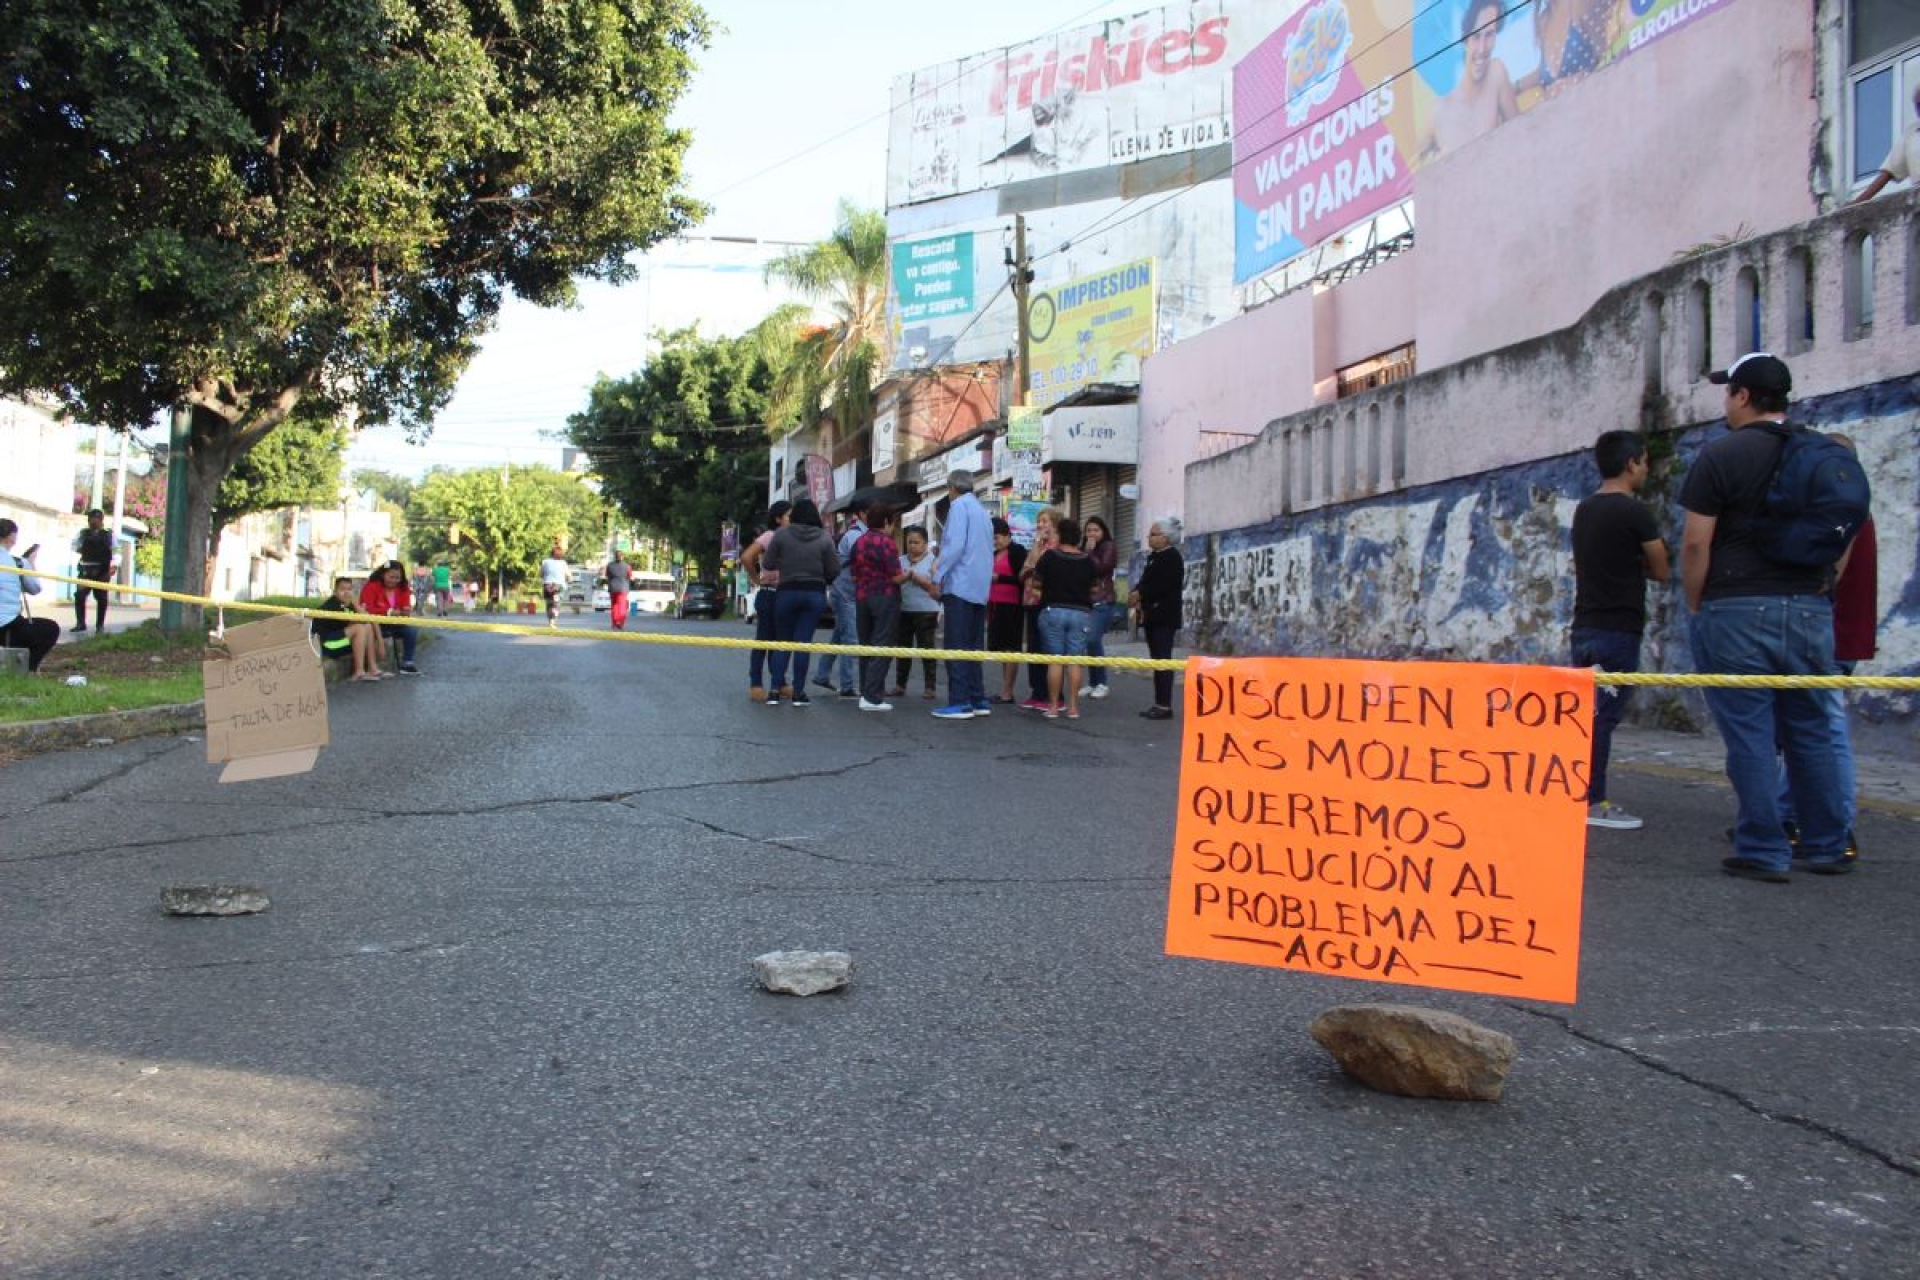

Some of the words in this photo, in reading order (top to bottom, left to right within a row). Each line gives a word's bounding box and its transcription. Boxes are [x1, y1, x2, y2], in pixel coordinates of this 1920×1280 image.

[988, 15, 1230, 118] Friskies
[1111, 133, 1151, 158] LLENA
[1158, 124, 1174, 150] DE
[1181, 122, 1214, 145] VIDA
[1255, 75, 1395, 196] VACACIONES
[1255, 193, 1293, 252] SIN
[1297, 132, 1396, 231] PARAR
[1057, 262, 1150, 312] IMPRESION
[274, 703, 295, 722] DE
[1195, 672, 1454, 730] DISCULPEN
[1486, 687, 1589, 738] POR
[1197, 732, 1287, 771] LAS
[1306, 738, 1590, 803] MOLESTIAS
[1192, 786, 1467, 850] QUEREMOS
[1450, 861, 1514, 900] AL
[1193, 882, 1436, 943] PROBLEMA
[1457, 909, 1556, 955] DEL
[1284, 934, 1420, 978] AGUA
